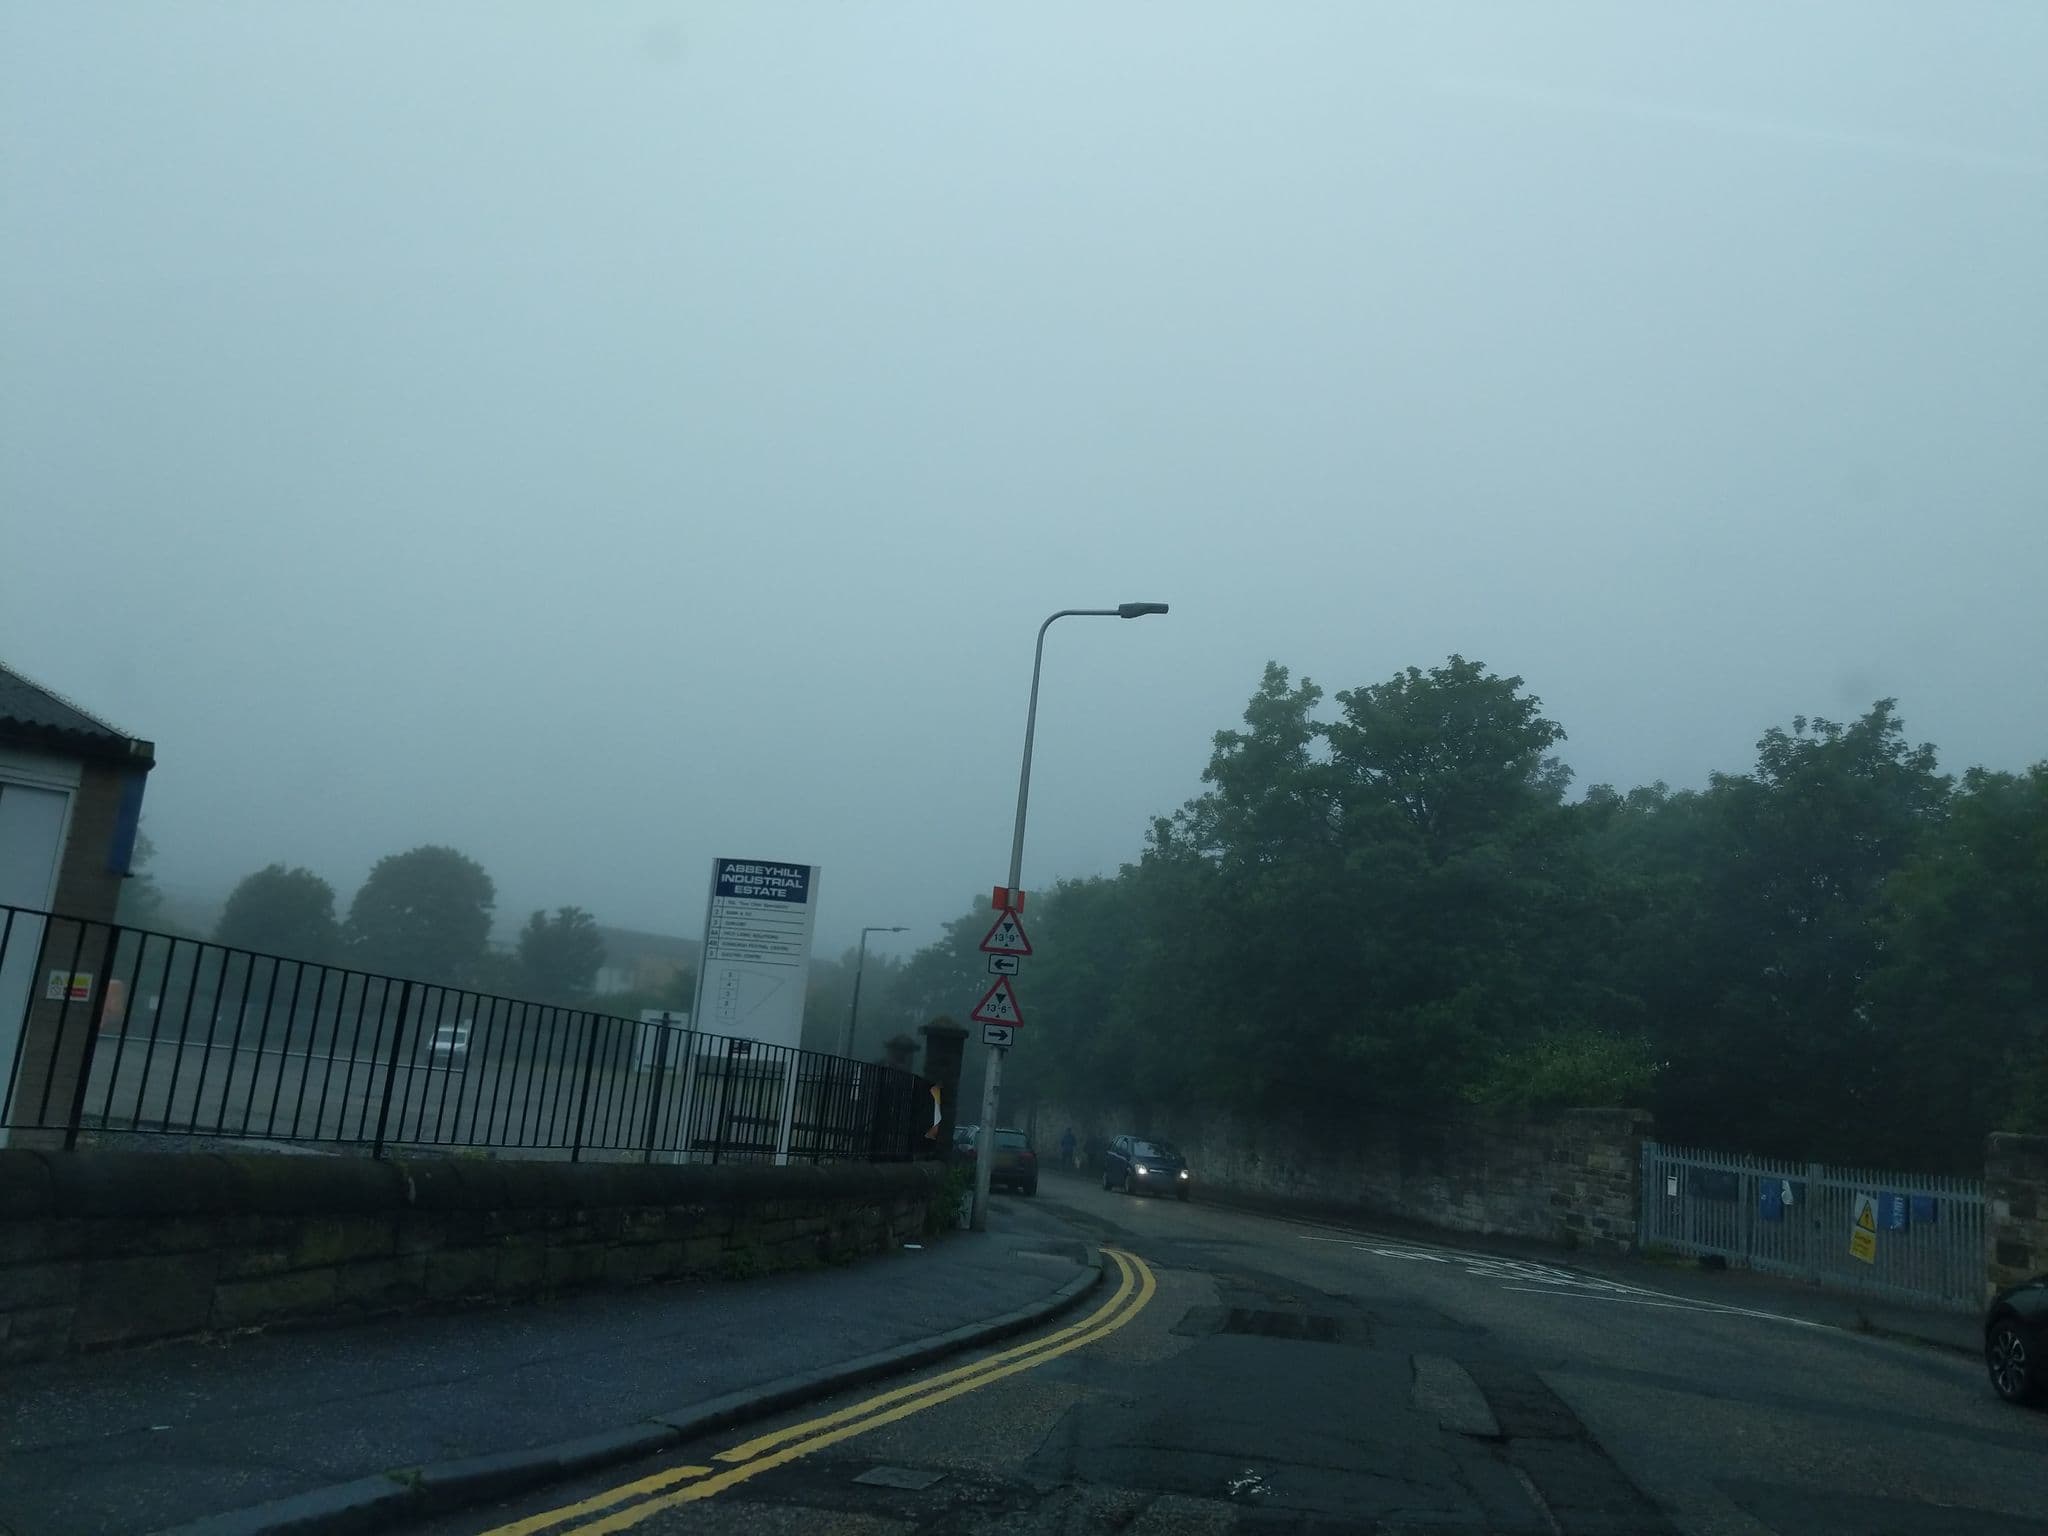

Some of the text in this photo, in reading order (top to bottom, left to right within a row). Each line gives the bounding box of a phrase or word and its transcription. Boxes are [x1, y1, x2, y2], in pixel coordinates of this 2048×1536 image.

[725, 864, 802, 878] ABBEYHILL
[721, 874, 803, 889] INDUSTRIAL
[734, 885, 787, 898] ESTATE
